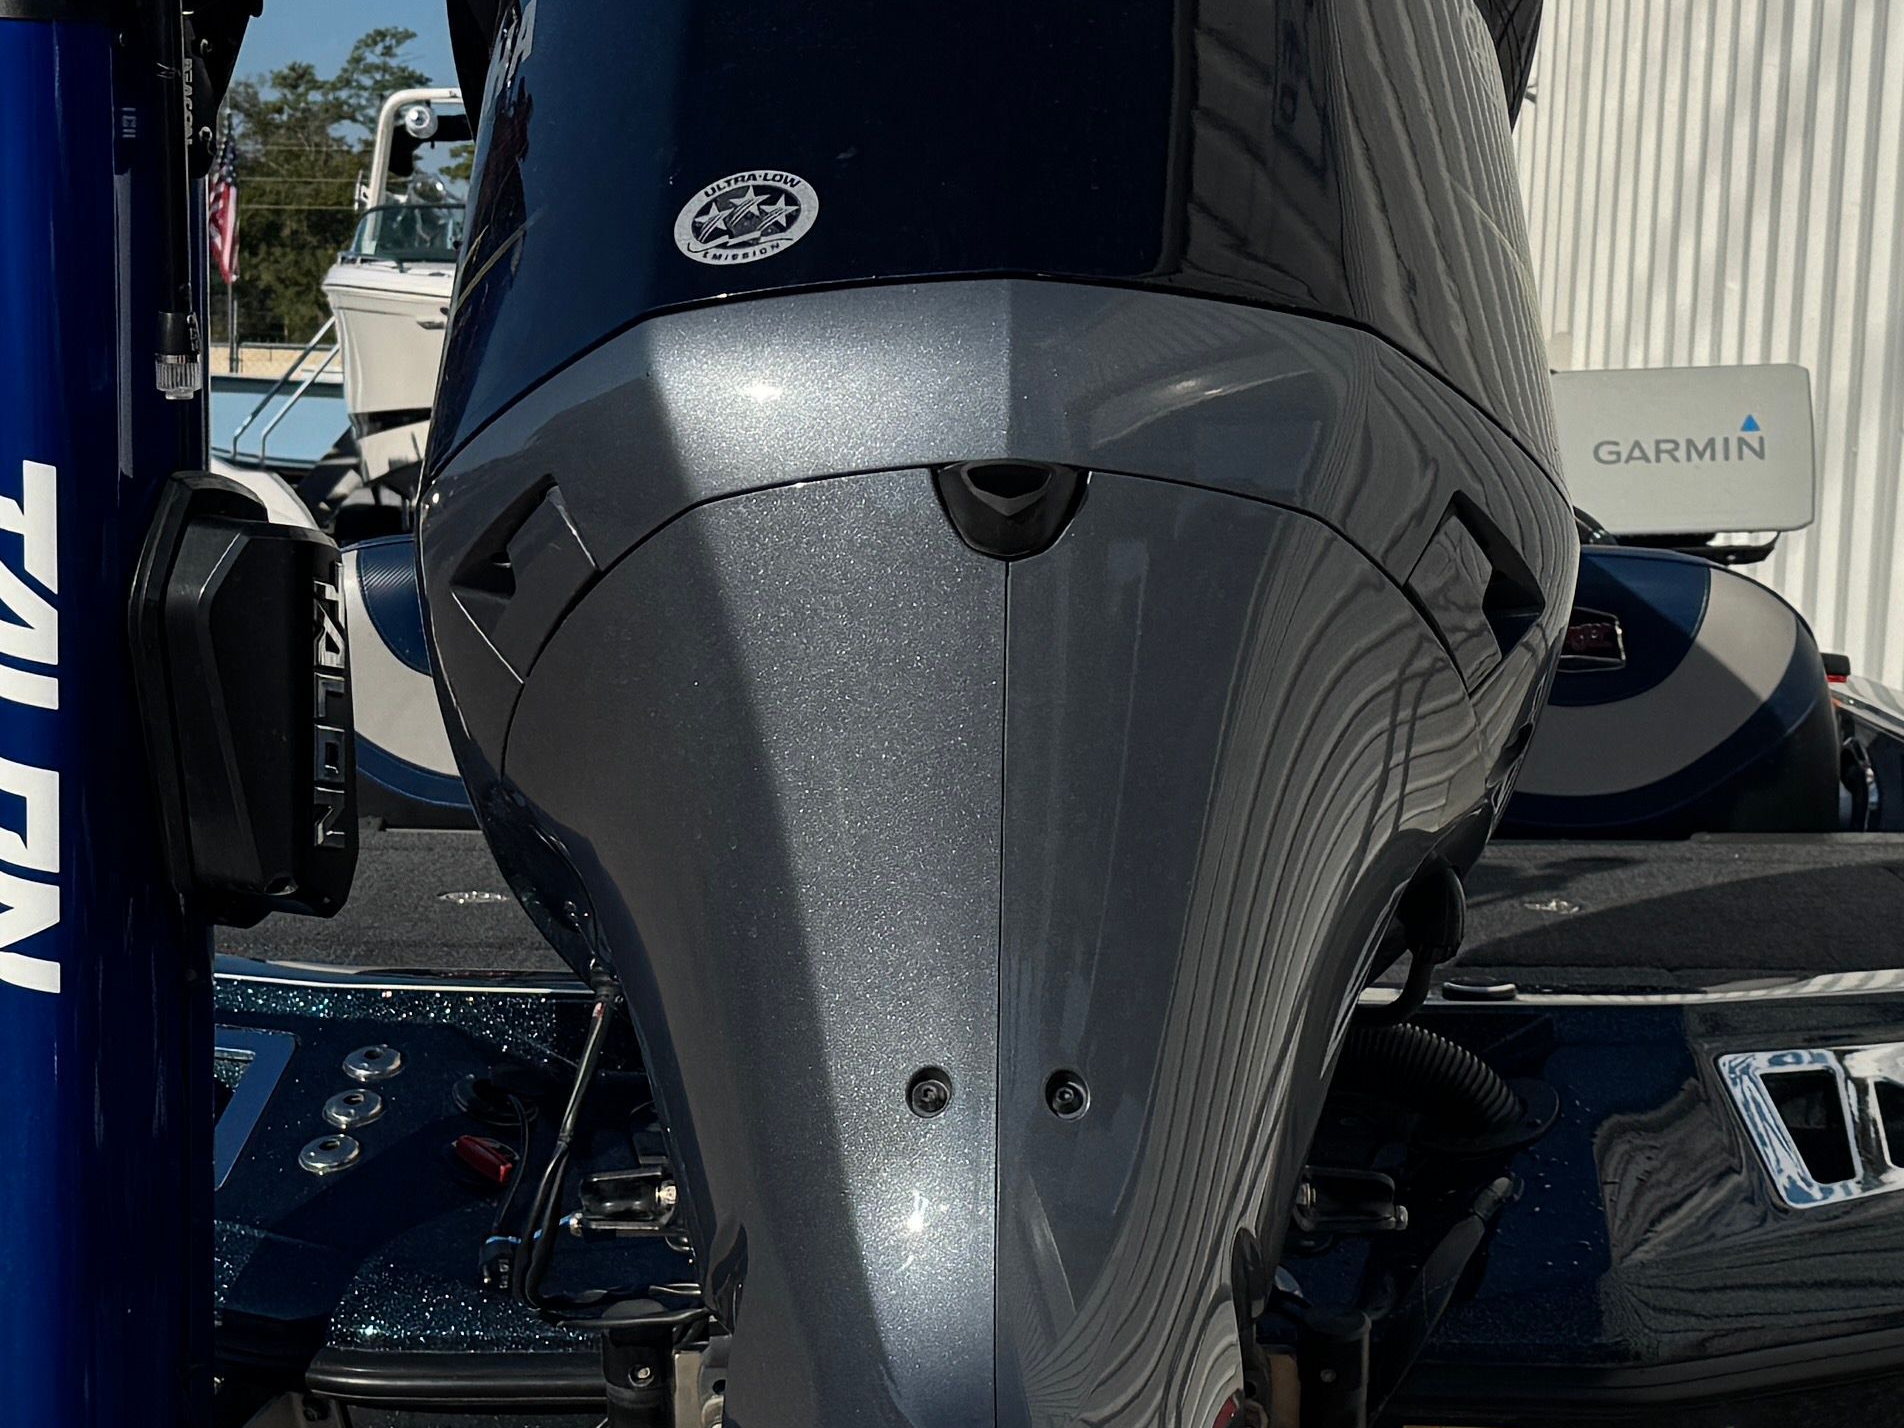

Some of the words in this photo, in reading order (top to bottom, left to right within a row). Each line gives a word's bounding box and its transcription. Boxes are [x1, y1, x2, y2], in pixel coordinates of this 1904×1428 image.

[702, 242, 781, 261] EMISSION
[1592, 435, 1766, 465] GARMIN
[313, 561, 346, 849] TALON
